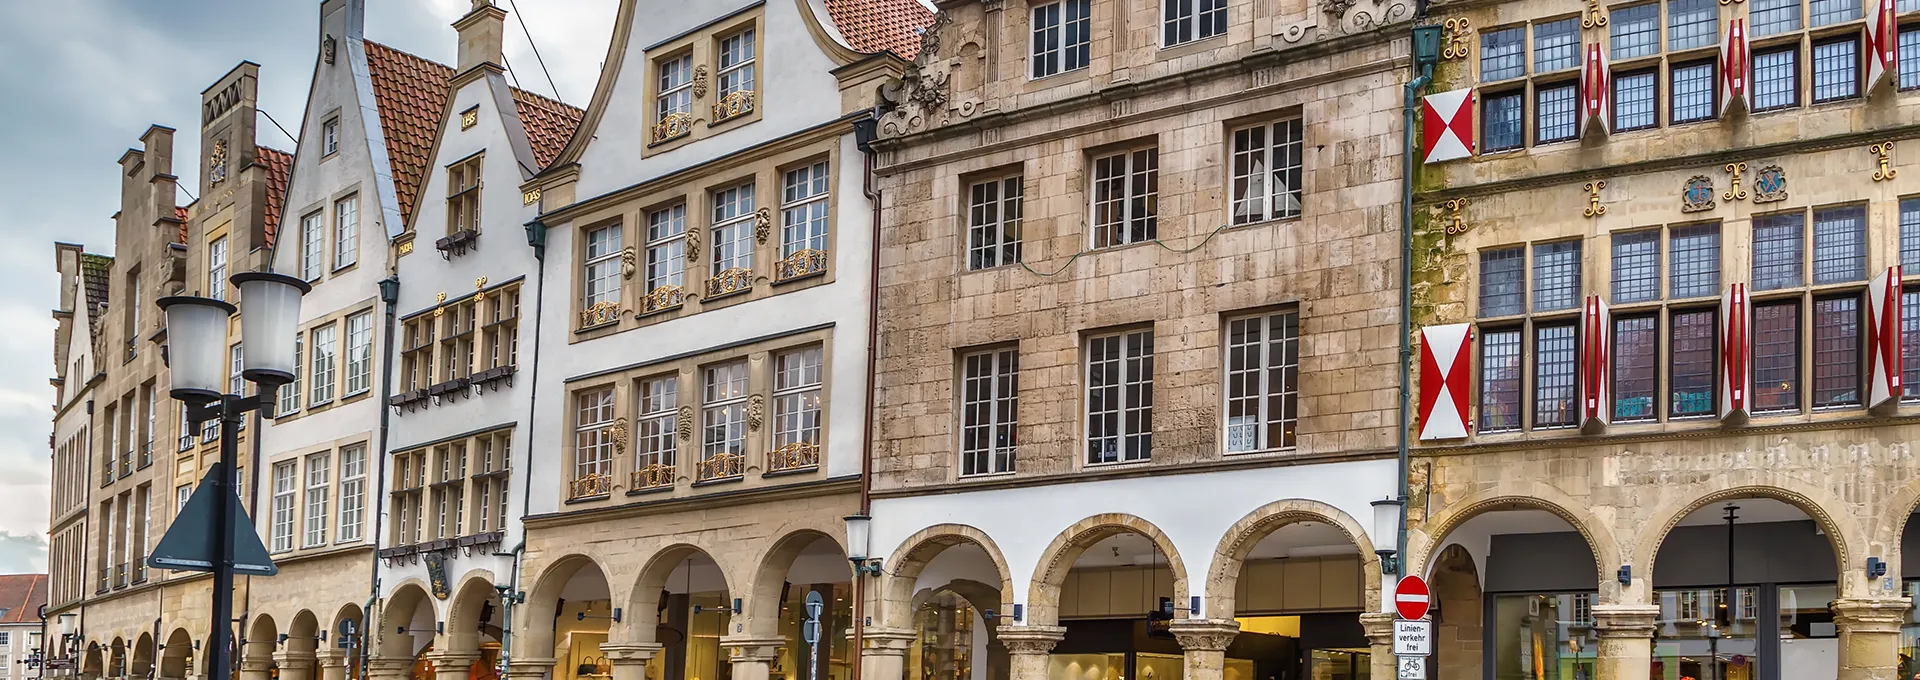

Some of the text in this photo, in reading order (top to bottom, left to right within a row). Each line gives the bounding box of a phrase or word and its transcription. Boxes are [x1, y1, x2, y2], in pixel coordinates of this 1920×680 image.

[1400, 624, 1425, 633] Linien-
[1398, 634, 1426, 642] verkehr
[1406, 642, 1419, 652] frei
